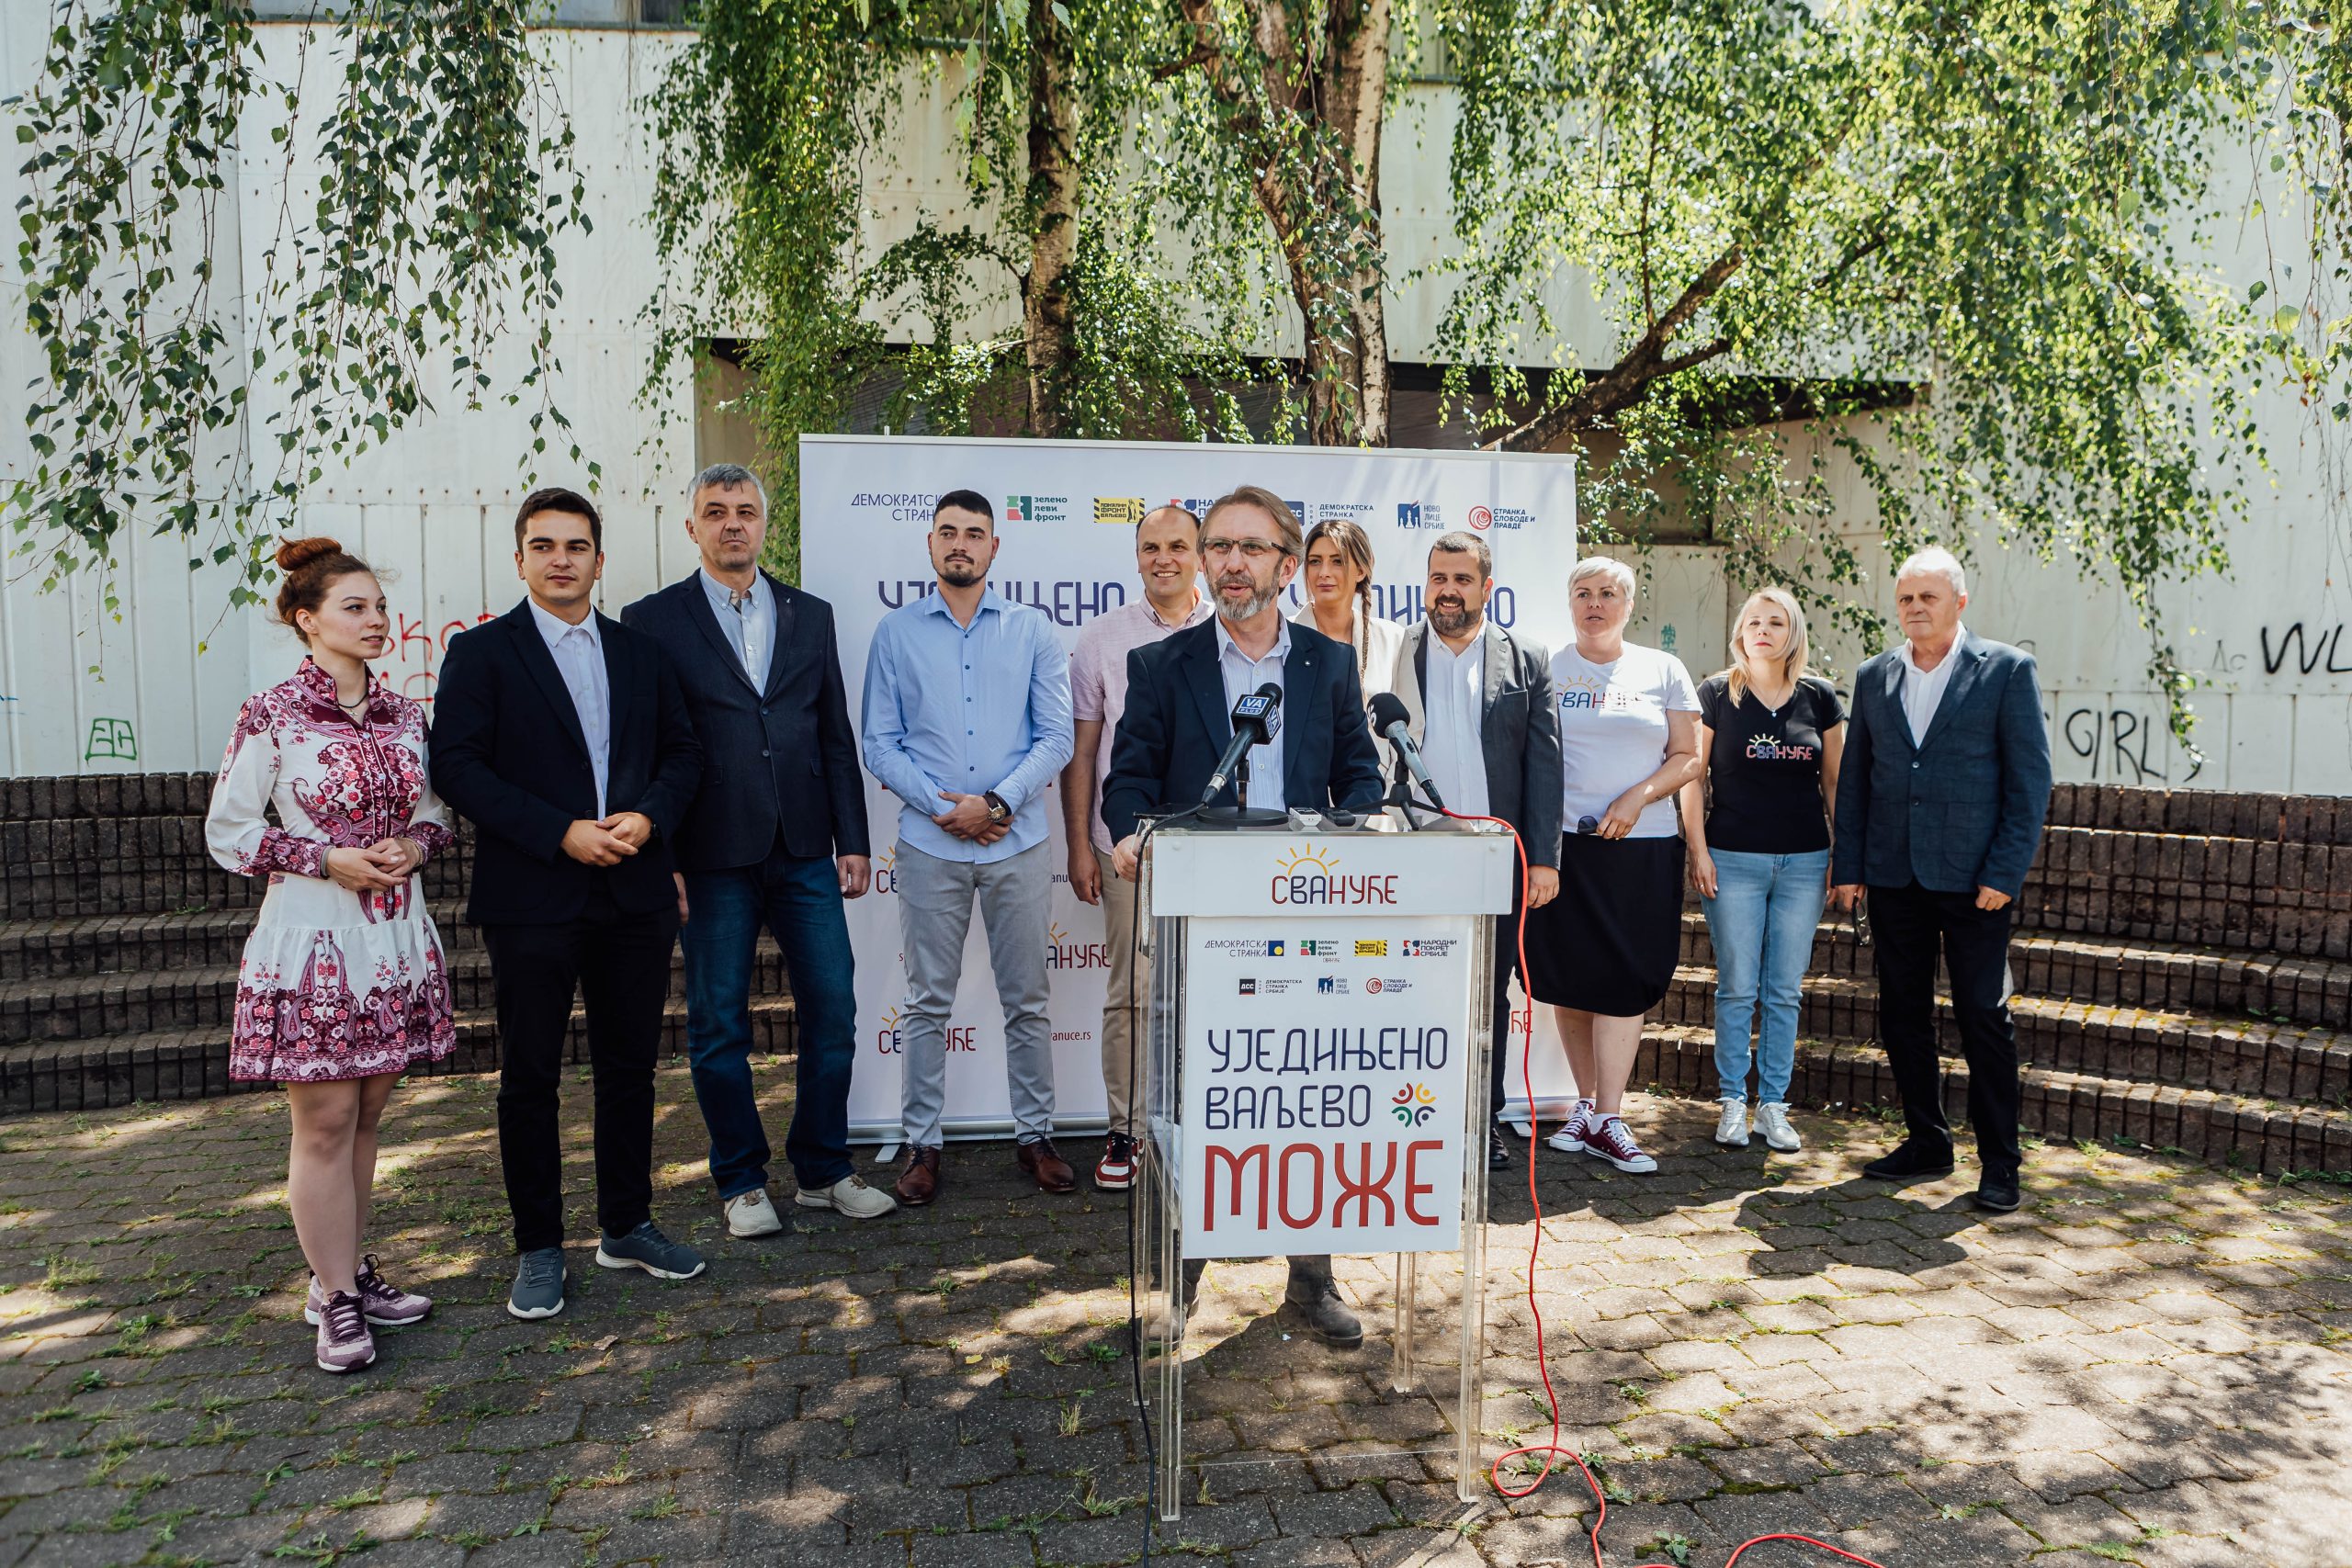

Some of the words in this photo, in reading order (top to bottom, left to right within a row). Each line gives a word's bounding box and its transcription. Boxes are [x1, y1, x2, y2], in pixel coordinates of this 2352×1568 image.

[851, 493, 943, 506] ДЕМОКРАТСК
[892, 509, 934, 521] СТРАН
[1035, 513, 1067, 523] фронт
[1424, 522, 1445, 530] СРБИЈЕ
[1246, 698, 1263, 707] VA
[1747, 745, 1813, 761] СВАНУЋЕ
[1272, 874, 1398, 905] СВАНУЋЕ
[1204, 940, 1267, 948] ДЕМОКРАТСКА
[1046, 944, 1111, 969] АНУЋЕ
[1229, 949, 1267, 957] СТРАНКА
[1050, 1031, 1091, 1041] anuce.rs
[1207, 1027, 1448, 1076] УЈЕДИЊЕНО
[1205, 1084, 1372, 1130] ВАЉЕВО
[1204, 1140, 1443, 1231] МОЖЕ
